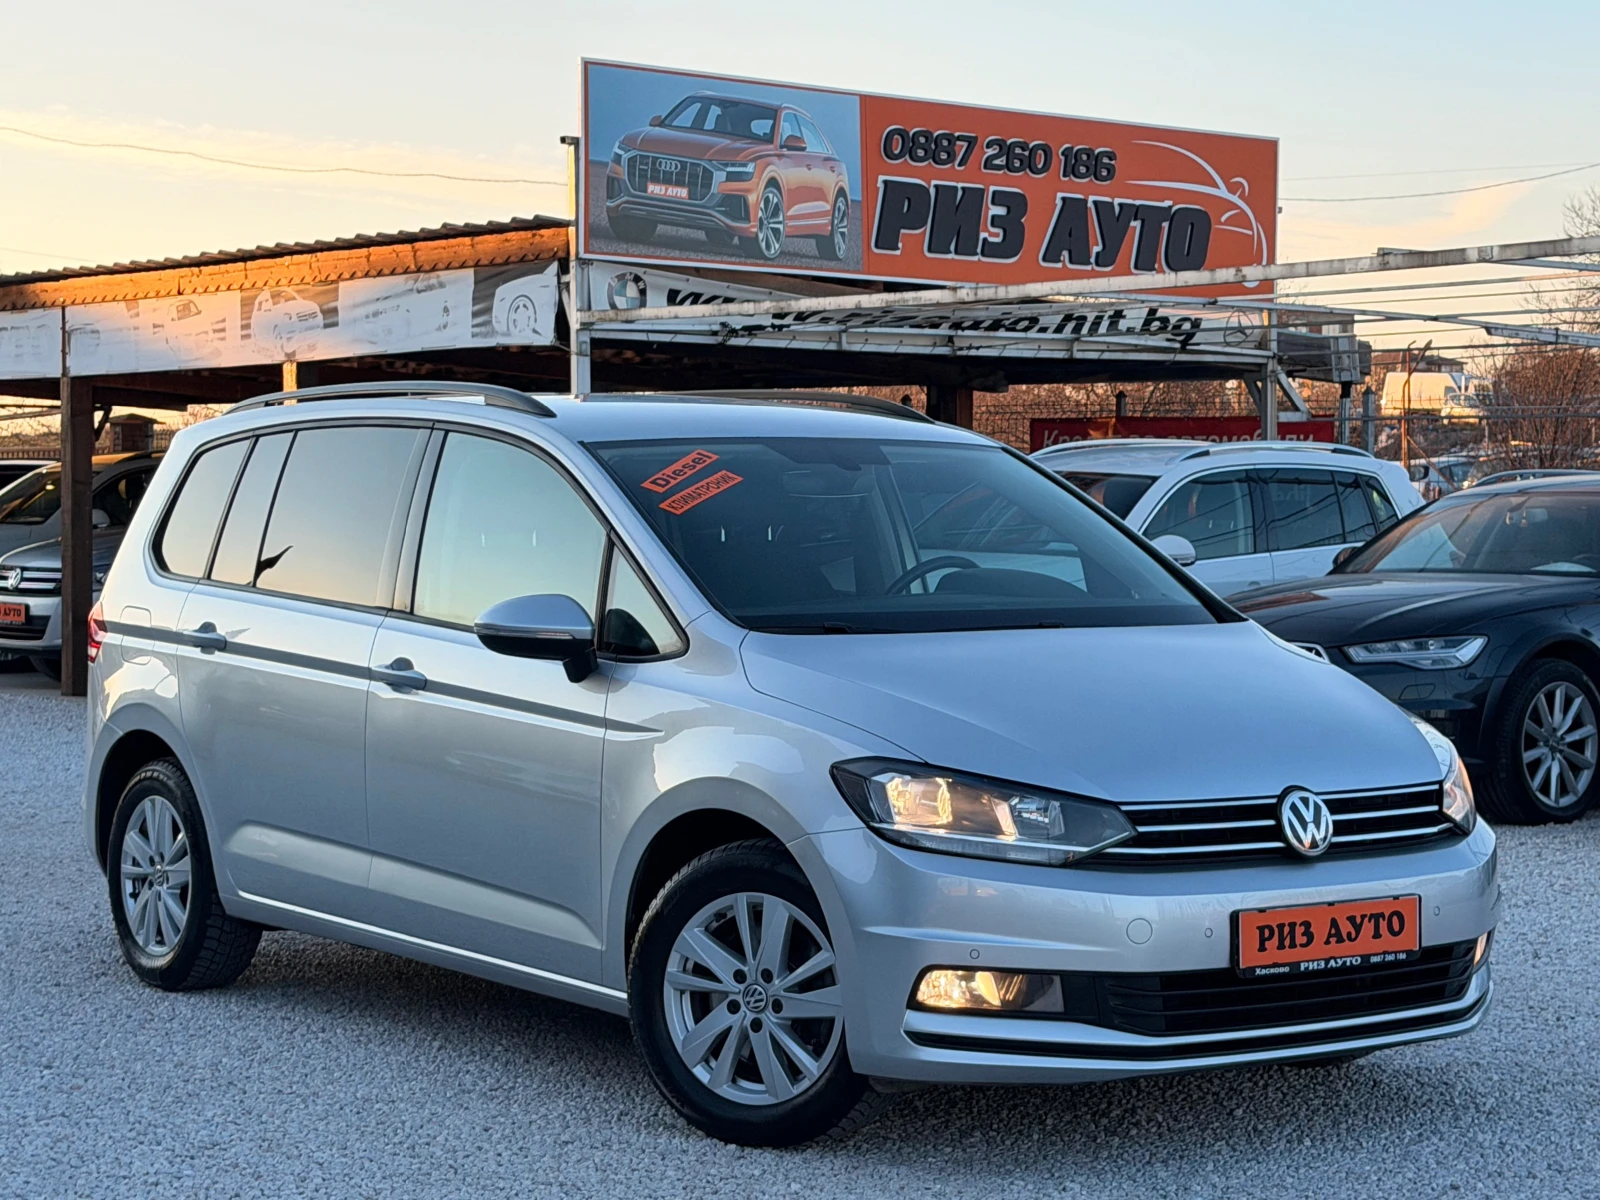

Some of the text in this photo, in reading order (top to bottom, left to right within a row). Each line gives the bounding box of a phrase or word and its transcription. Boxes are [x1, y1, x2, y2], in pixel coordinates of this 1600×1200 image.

[881, 125, 1117, 184] 0887 260 186
[648, 185, 687, 198] РИЗ АУТО
[871, 175, 1212, 274] РИЗ АУТО
[648, 452, 713, 489] Diesel
[666, 472, 738, 512] КЛИМАТРОНИК
[1283, 791, 1332, 854] VW
[1256, 910, 1406, 952] РИЗ АУТО
[1255, 966, 1290, 976] Хасково
[1300, 960, 1325, 972] РИЗ
[1327, 956, 1362, 968] АУТО
